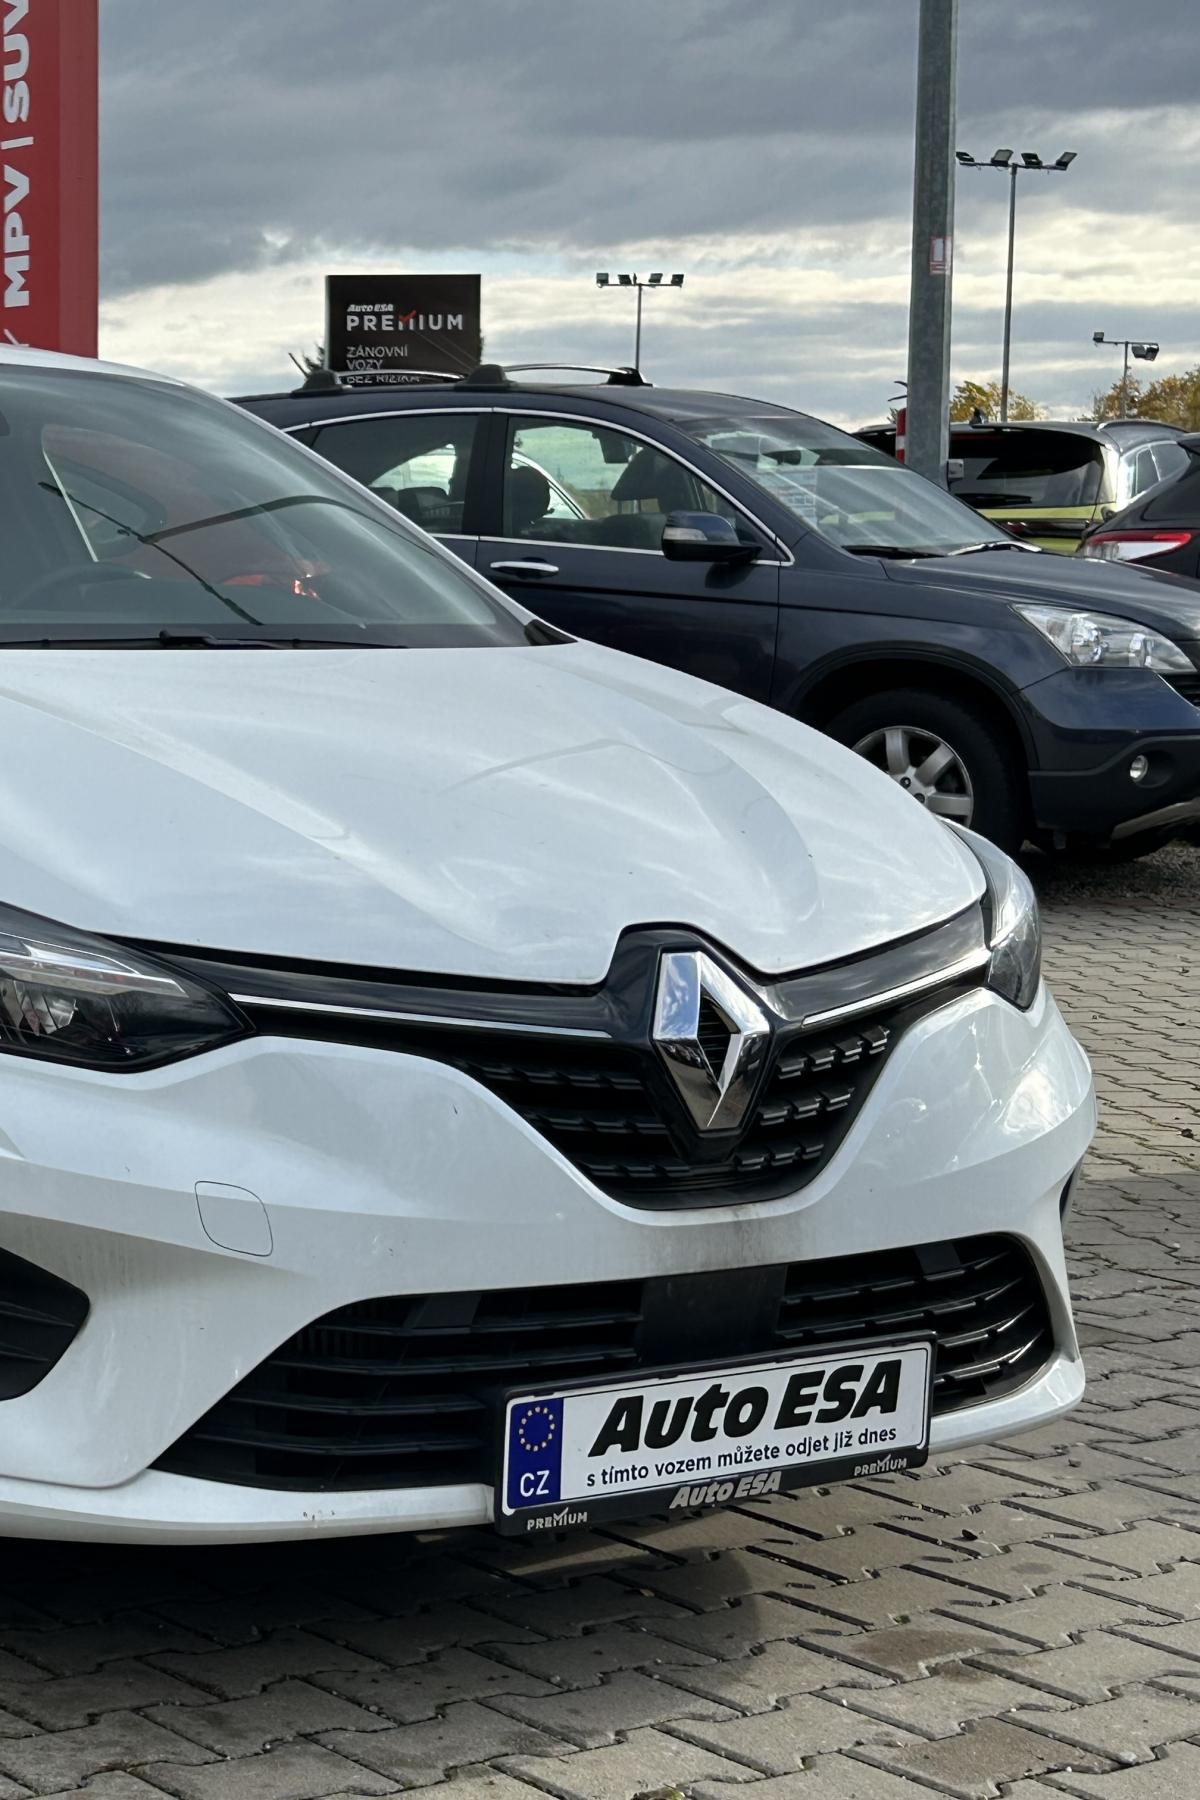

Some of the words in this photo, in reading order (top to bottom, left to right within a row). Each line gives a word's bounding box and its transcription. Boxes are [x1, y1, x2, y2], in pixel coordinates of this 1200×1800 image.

[3, 0, 30, 123] SUV
[4, 164, 30, 308] MPV
[346, 310, 464, 331] PREMIUM
[346, 344, 409, 358] ZÁNOVNÍ
[346, 359, 383, 370] VOZY
[588, 1383, 769, 1458] Auto
[774, 1359, 903, 1430] ESA
[519, 1469, 550, 1497] CZ
[586, 1473, 595, 1487] s
[600, 1461, 649, 1485] tímto
[654, 1455, 712, 1477] vozem
[717, 1445, 781, 1468] můžete
[785, 1435, 829, 1457] odjet
[857, 1427, 897, 1446] dnes
[526, 1507, 588, 1531] PREMIUM
[669, 1477, 734, 1509] Auto
[735, 1471, 782, 1498] ESA
[853, 1454, 908, 1476] PREMIUM
